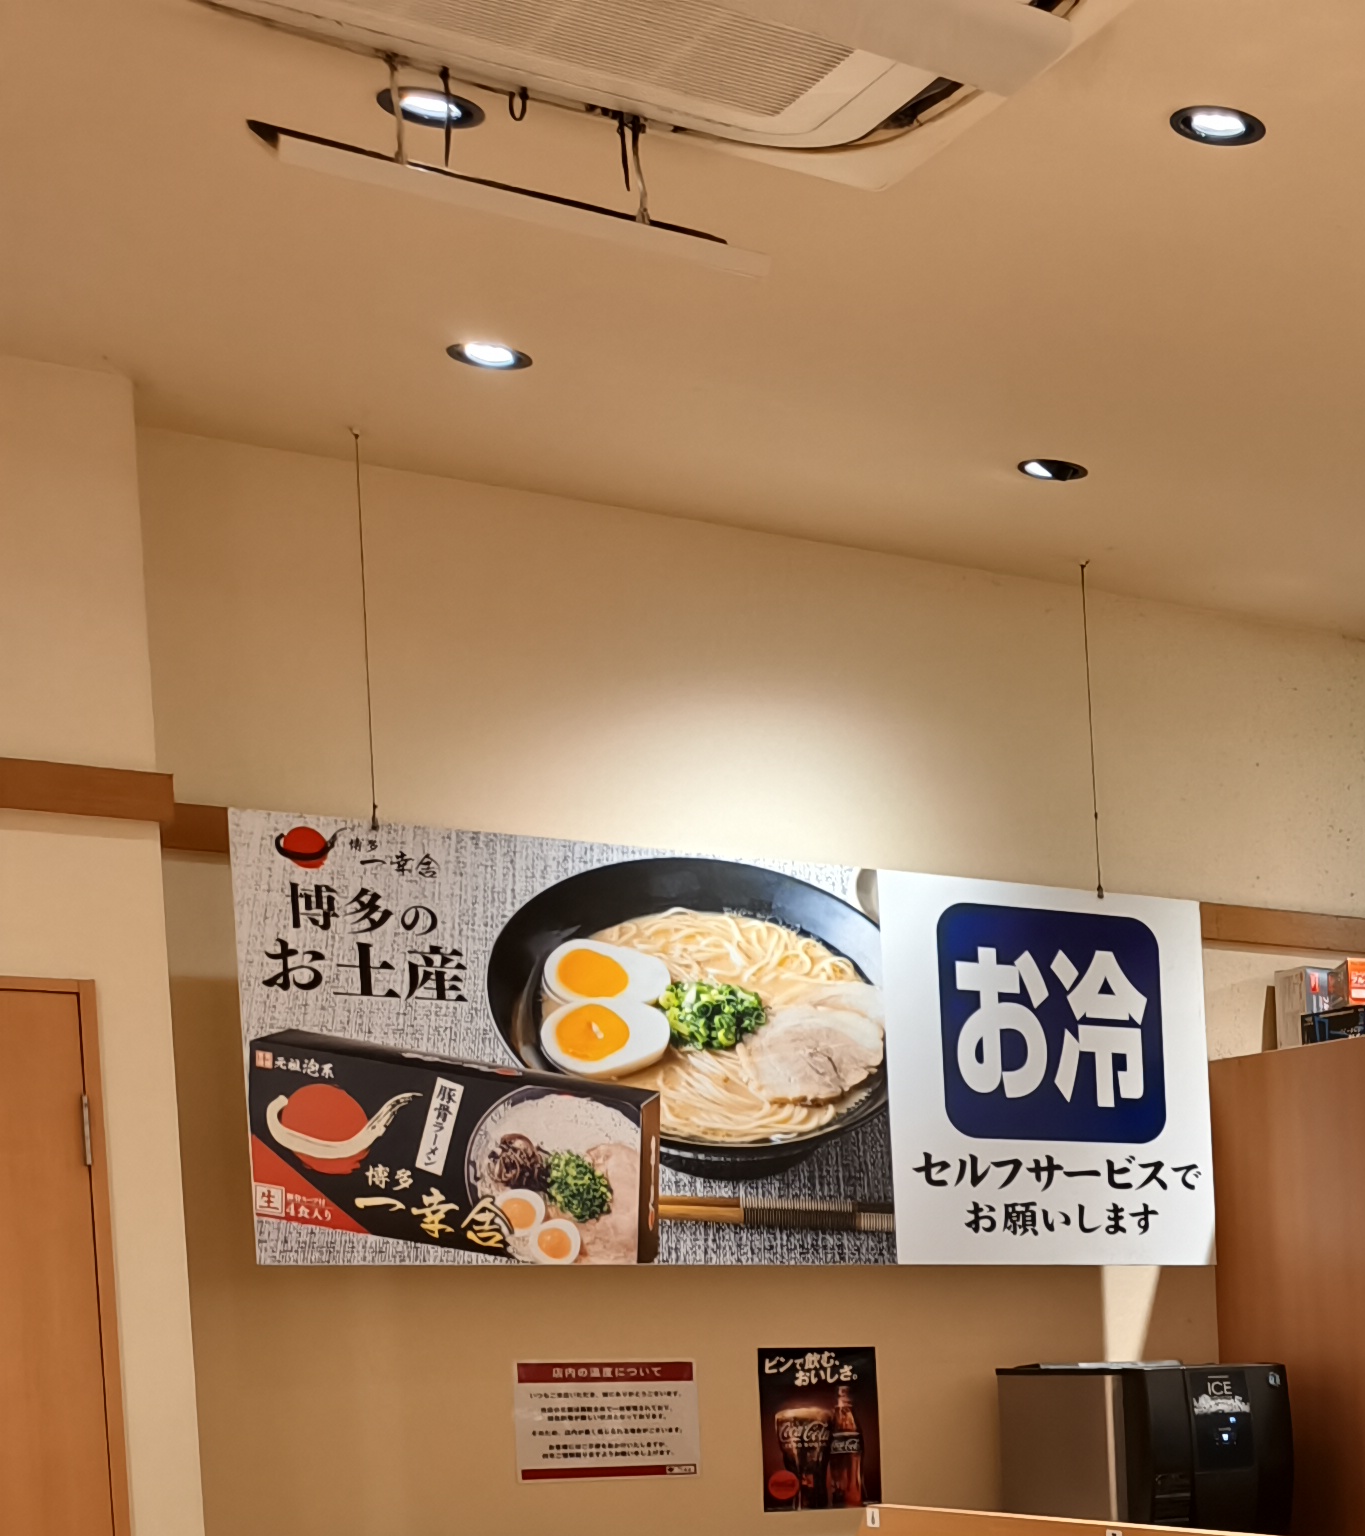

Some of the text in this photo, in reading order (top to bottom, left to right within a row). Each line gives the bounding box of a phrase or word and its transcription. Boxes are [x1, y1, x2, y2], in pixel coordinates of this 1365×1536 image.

[348, 837, 380, 851] 博多
[288, 881, 438, 935] 博多の
[262, 937, 468, 1004] お土産
[954, 945, 1148, 1108] お冷
[424, 1083, 458, 1168] 豚骨ラーメン
[365, 1164, 414, 1191] 博多
[912, 1151, 1202, 1193] セルフサービスで
[257, 1190, 280, 1211] 生
[286, 1204, 332, 1222] 4食入り
[964, 1201, 1160, 1237] お願いします
[552, 1366, 663, 1379] 店内の温度について
[765, 1351, 839, 1374] ビンで飲む、
[794, 1365, 858, 1387] おいしさ。
[1207, 1381, 1232, 1396] ICE
